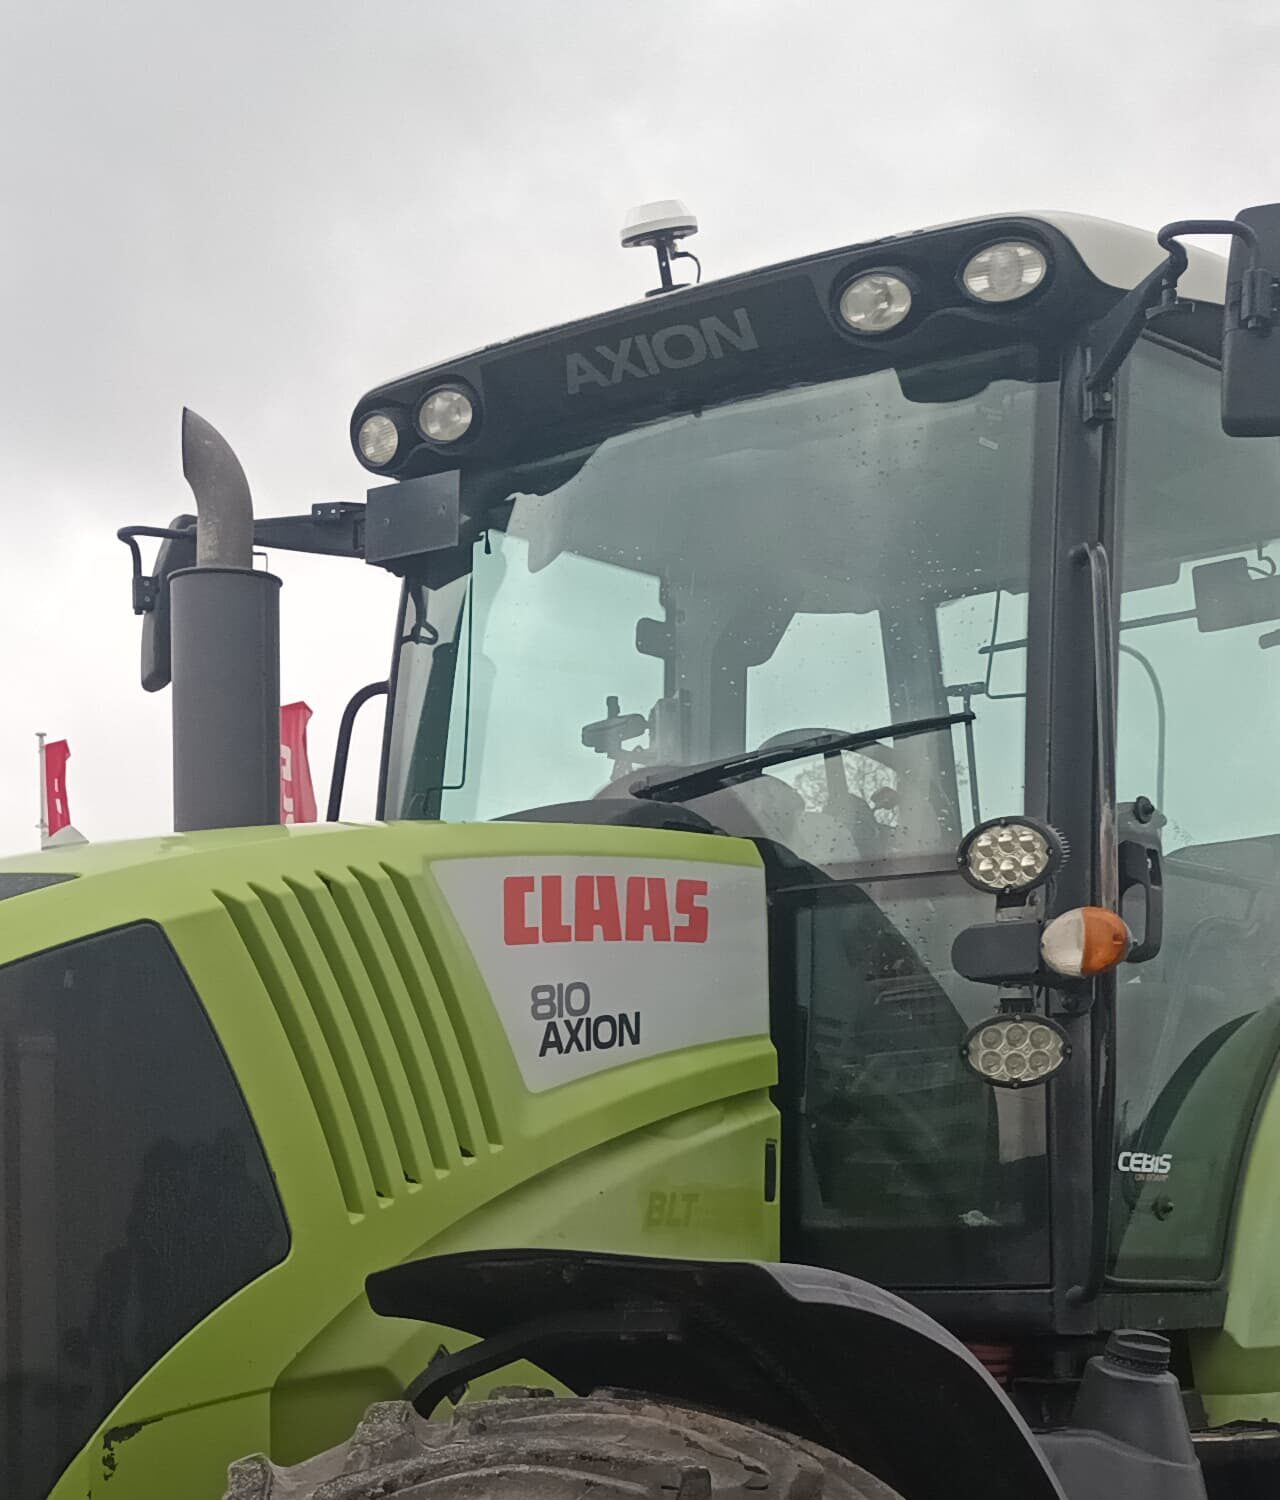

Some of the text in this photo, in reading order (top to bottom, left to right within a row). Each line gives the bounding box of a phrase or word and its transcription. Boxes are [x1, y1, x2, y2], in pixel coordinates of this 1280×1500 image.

[566, 307, 759, 395] AXION
[503, 874, 709, 946] CLAAS
[531, 981, 591, 1021] 810
[538, 1011, 641, 1058] AXION
[1117, 1151, 1174, 1174] CEBIS
